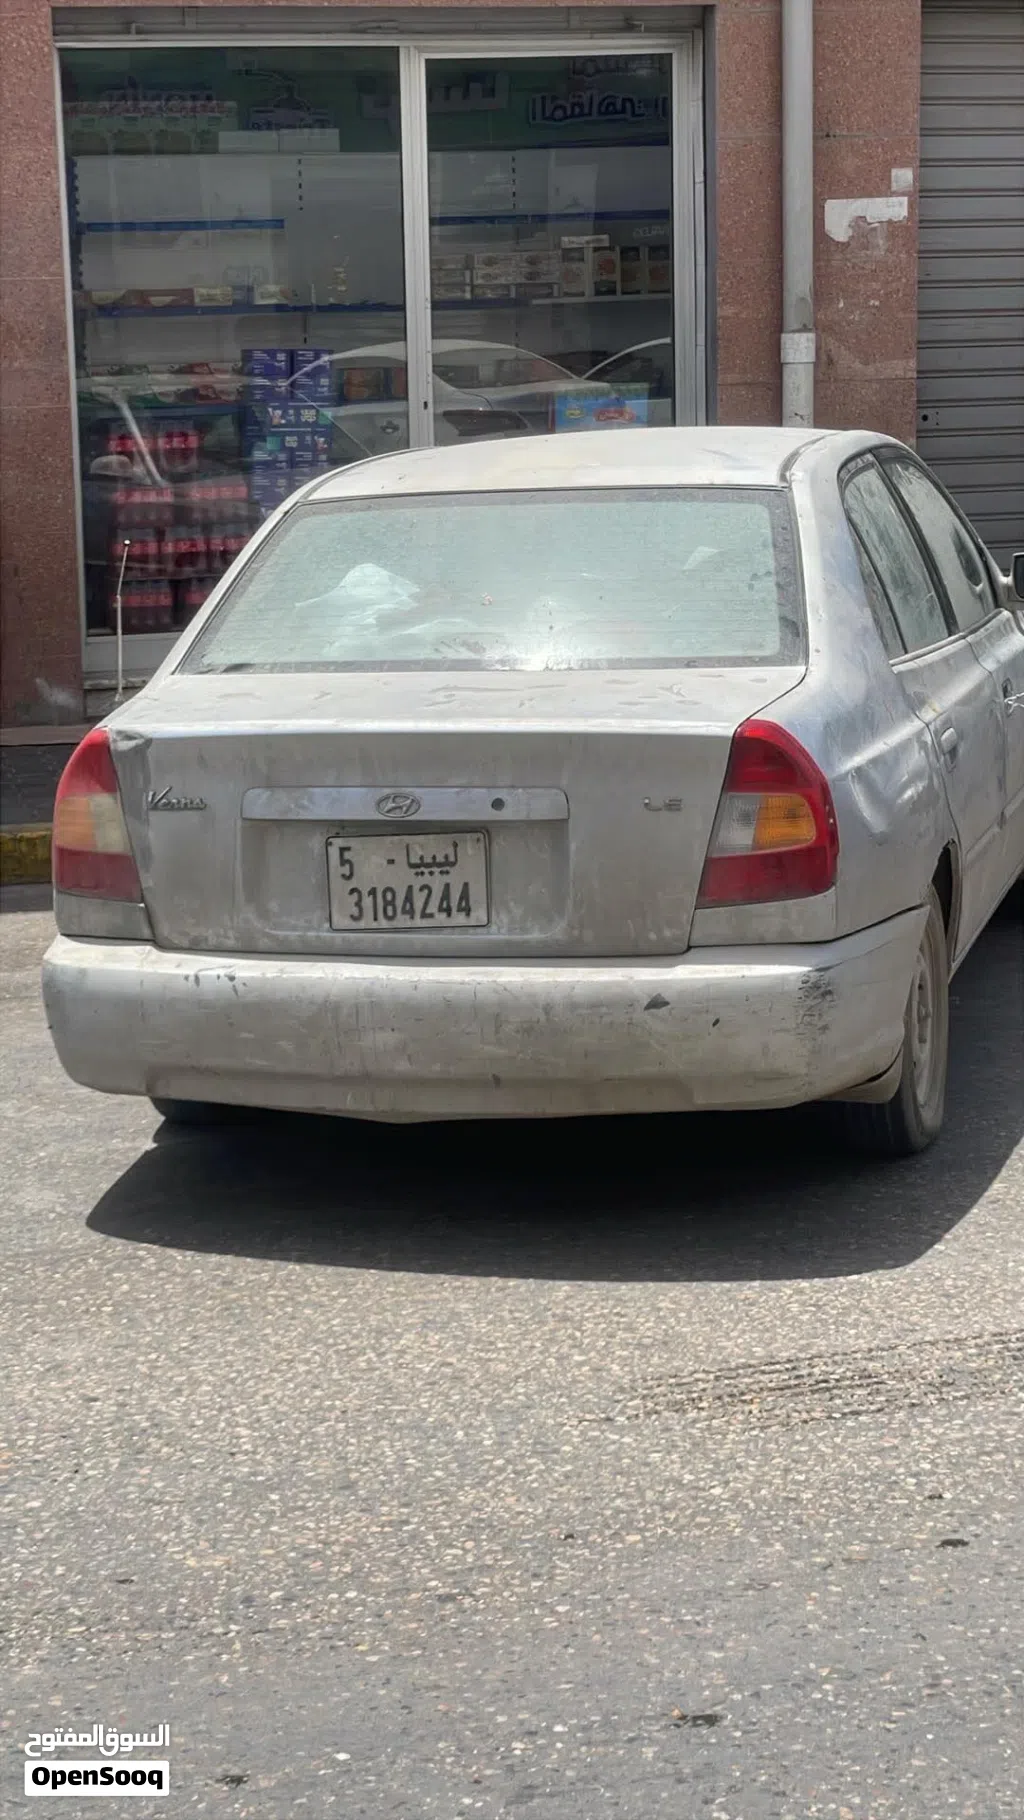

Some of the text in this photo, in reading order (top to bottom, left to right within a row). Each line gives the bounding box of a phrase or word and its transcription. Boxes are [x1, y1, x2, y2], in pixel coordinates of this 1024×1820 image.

[147, 786, 207, 811] Verna
[338, 846, 355, 881] 5
[405, 841, 459, 877] ليبيا
[347, 881, 472, 922] 3184244
